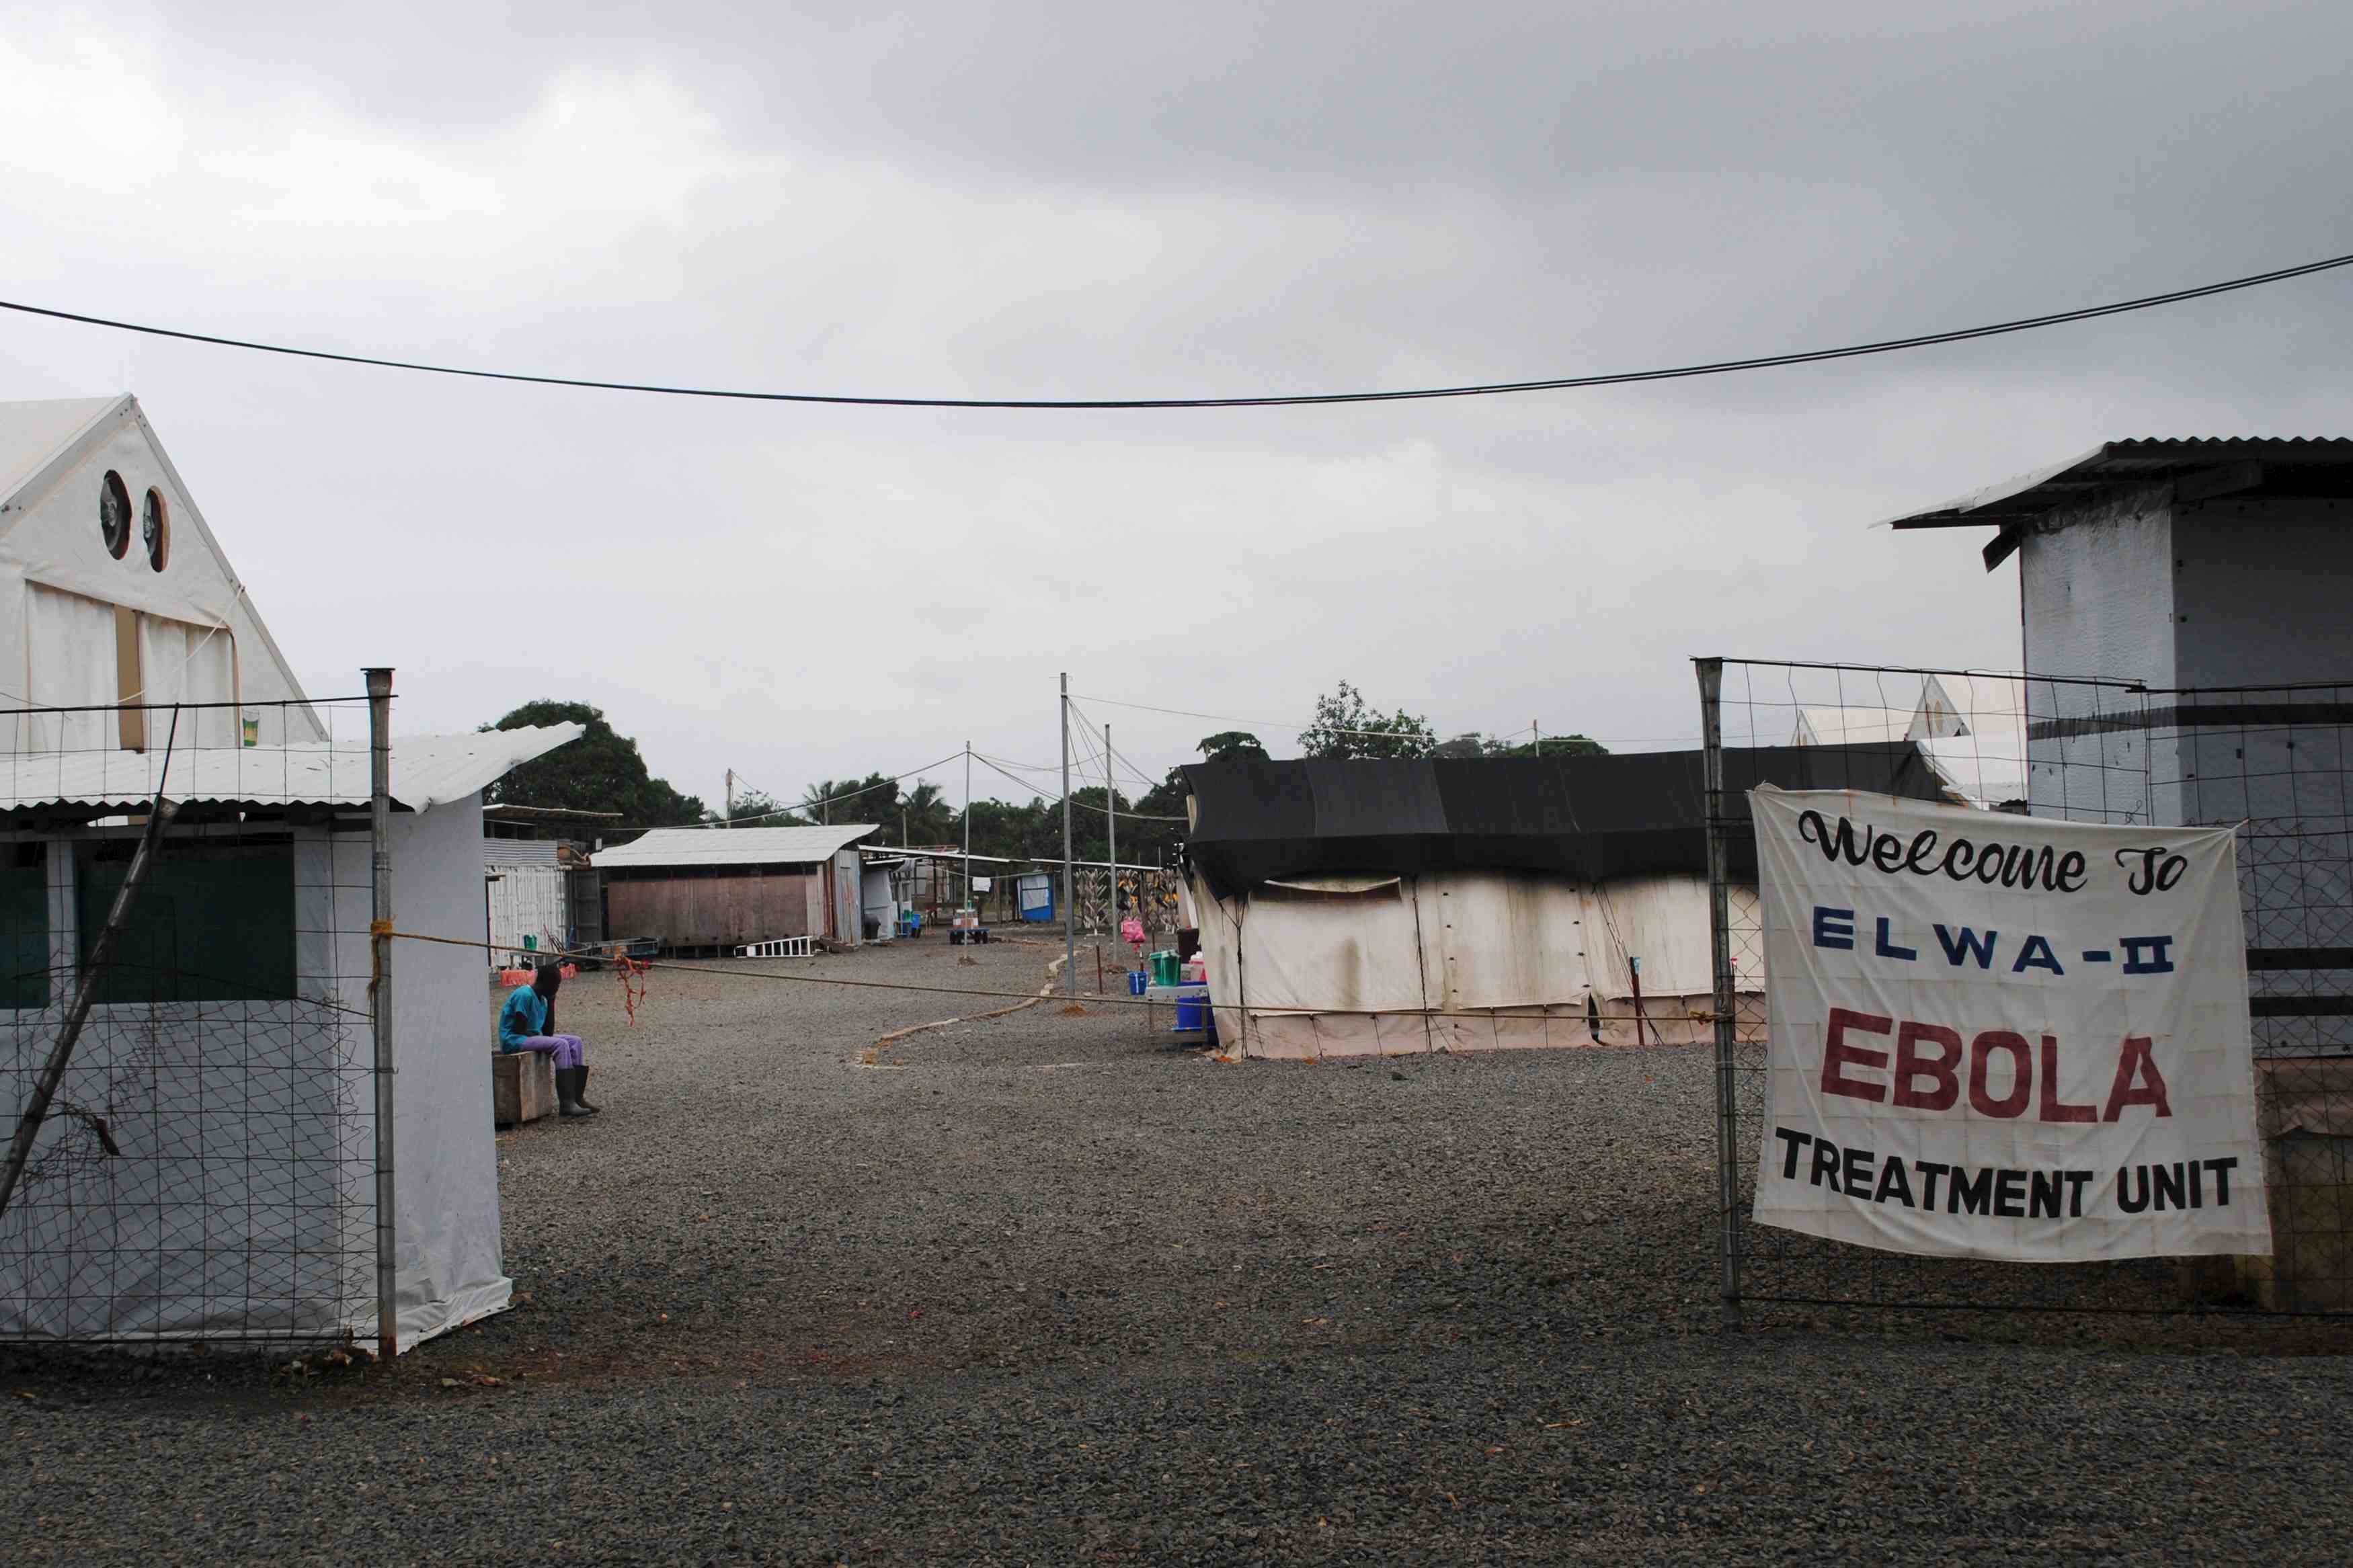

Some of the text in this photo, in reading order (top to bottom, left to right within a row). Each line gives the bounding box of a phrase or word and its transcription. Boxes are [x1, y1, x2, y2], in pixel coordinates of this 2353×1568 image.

[1798, 810, 2188, 896] Welcome To
[1812, 905, 2175, 976] ELWA-II
[1820, 1007, 2173, 1123] EBOLA
[1775, 1126, 2238, 1219] TREATMENT UNIT
